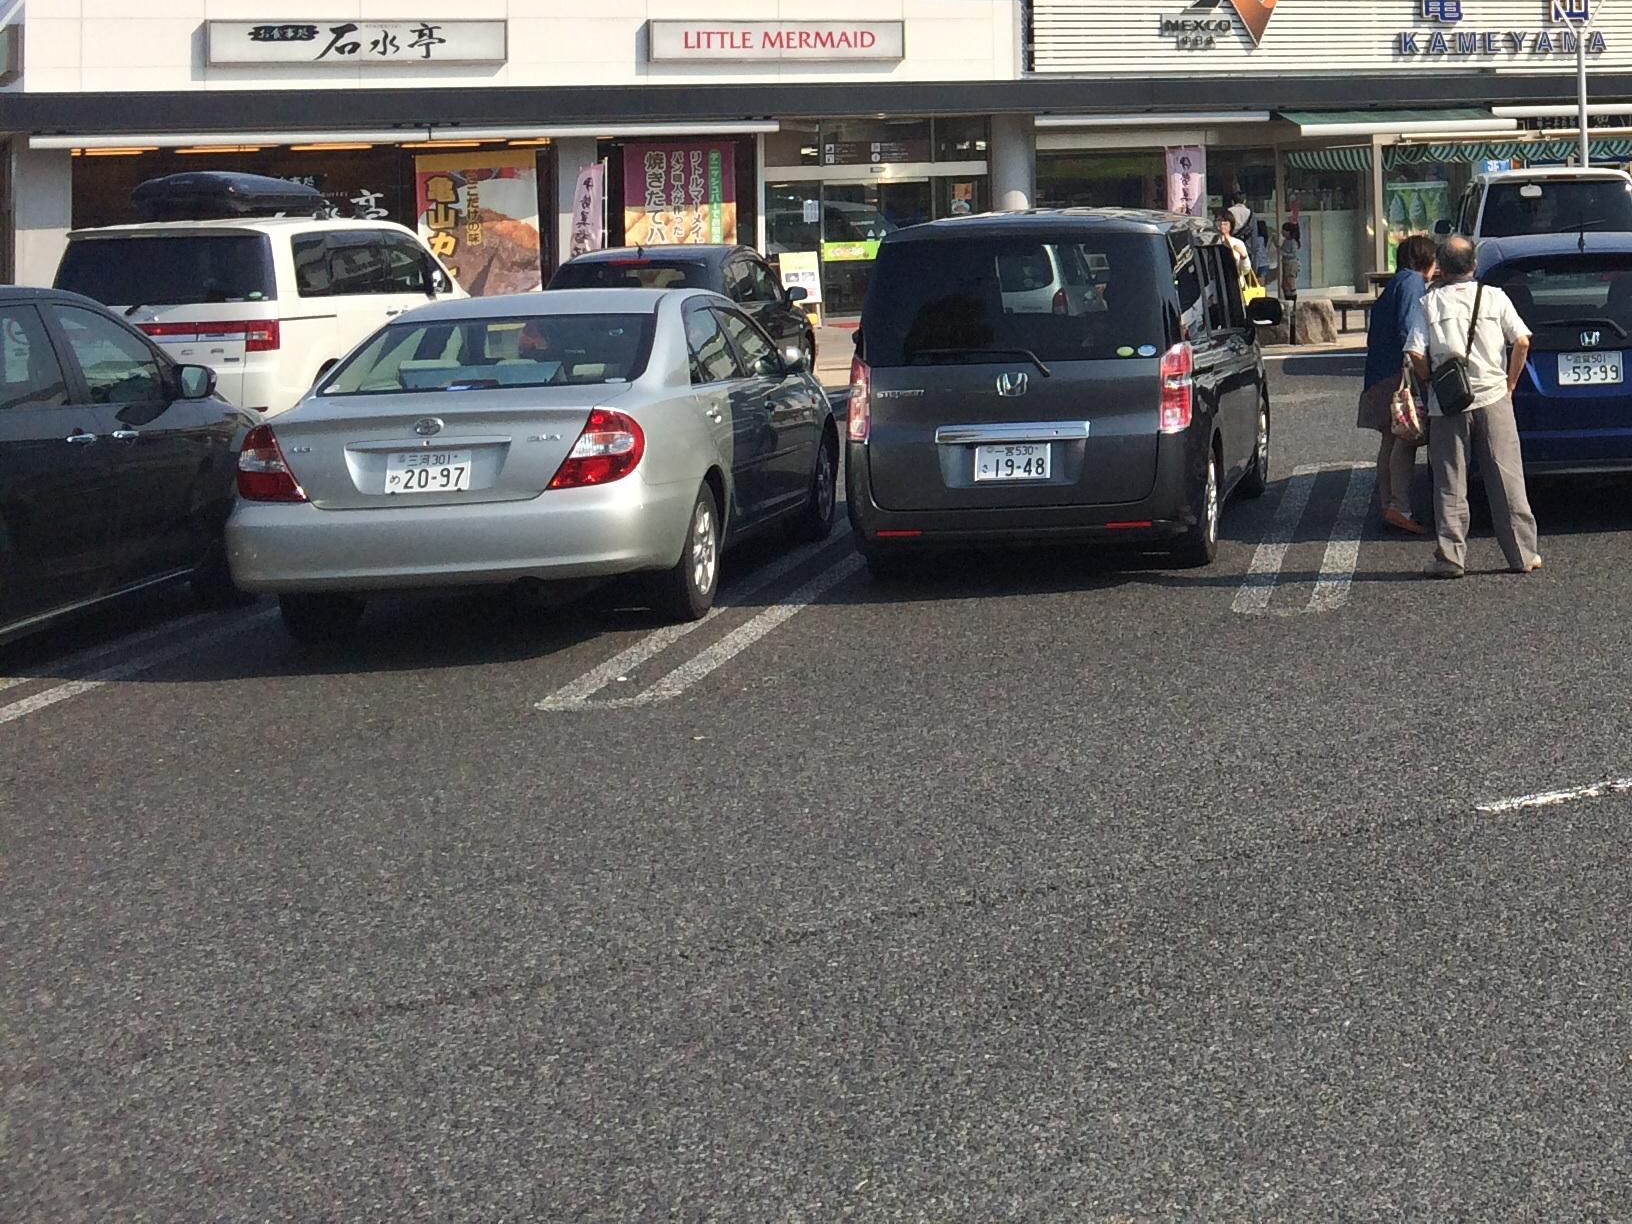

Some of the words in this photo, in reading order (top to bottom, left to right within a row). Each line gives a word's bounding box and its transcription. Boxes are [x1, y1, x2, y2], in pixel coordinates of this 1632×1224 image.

[1164, 19, 1232, 32] NEXCO
[314, 23, 447, 61] 石水亭
[684, 31, 753, 49] LITTLE
[762, 31, 876, 49] MERMAID
[1402, 31, 1607, 53] KAMEYAMA
[1572, 364, 1619, 382] 53-99
[996, 457, 1045, 477] 19-48
[403, 466, 465, 490] 20-97
